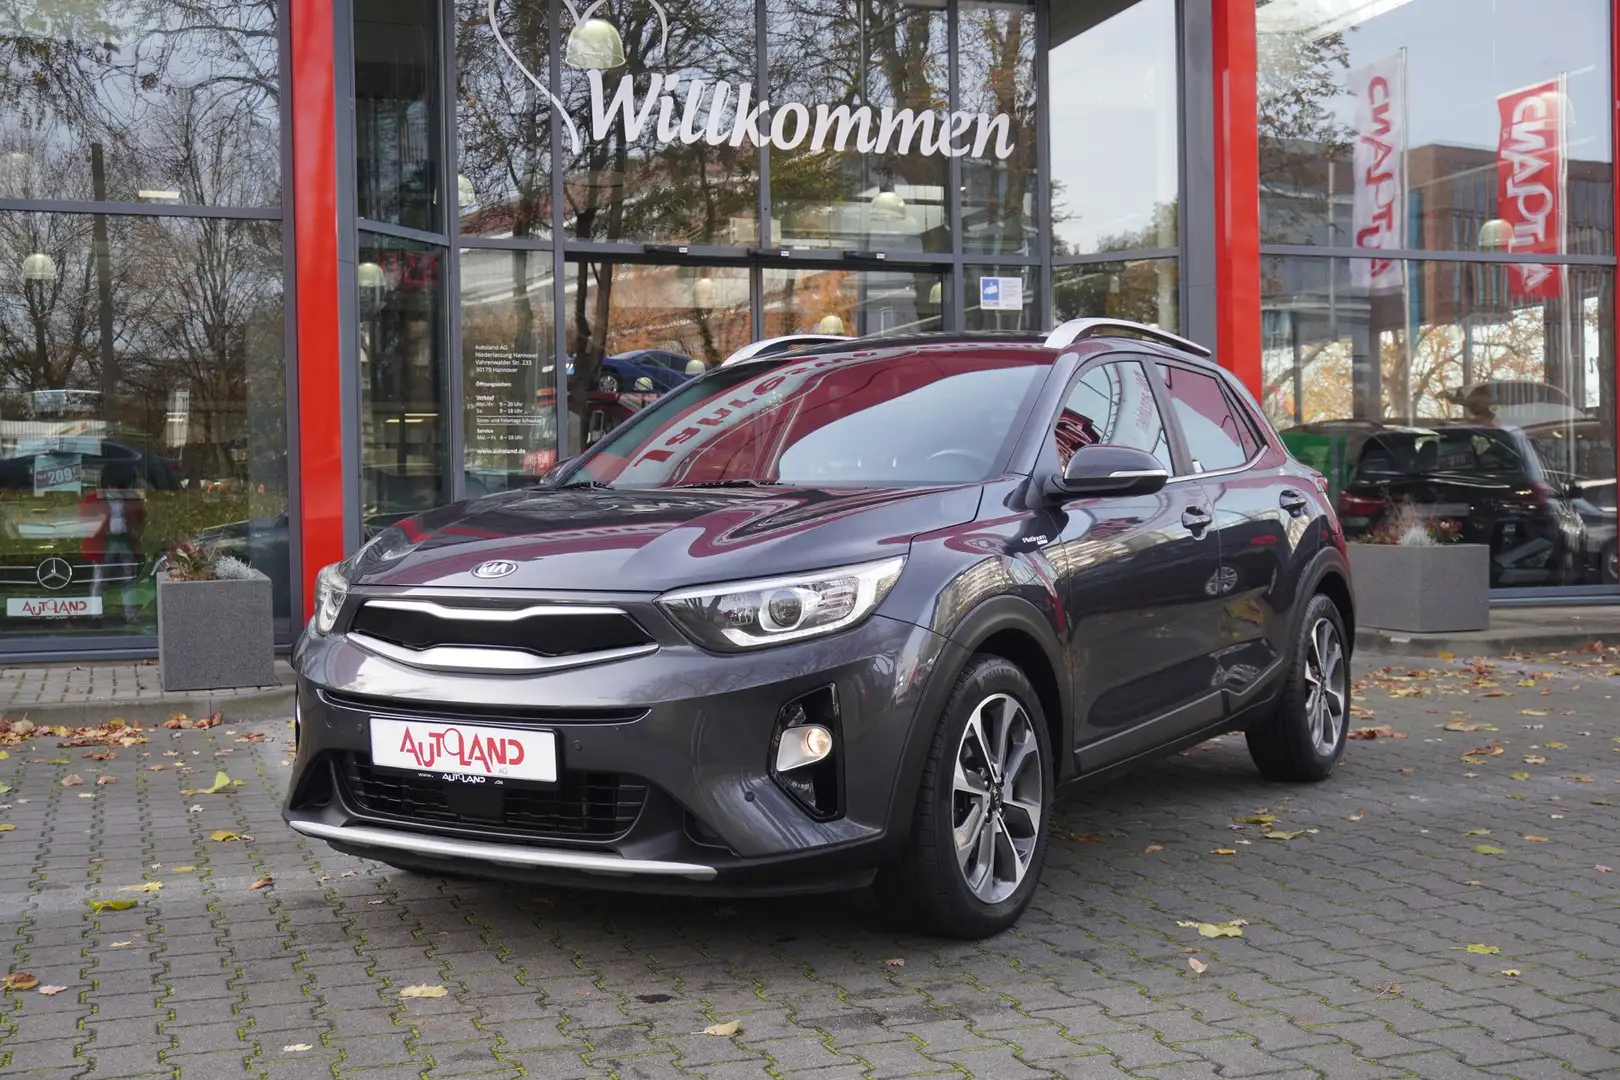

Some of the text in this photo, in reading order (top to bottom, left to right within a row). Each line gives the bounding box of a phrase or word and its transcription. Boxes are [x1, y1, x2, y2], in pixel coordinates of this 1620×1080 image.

[586, 69, 1015, 159] Willkommen
[23, 600, 87, 615] AUTOLAND
[400, 726, 525, 773] AUTOLAND
[442, 772, 486, 784] AUTOLAND
